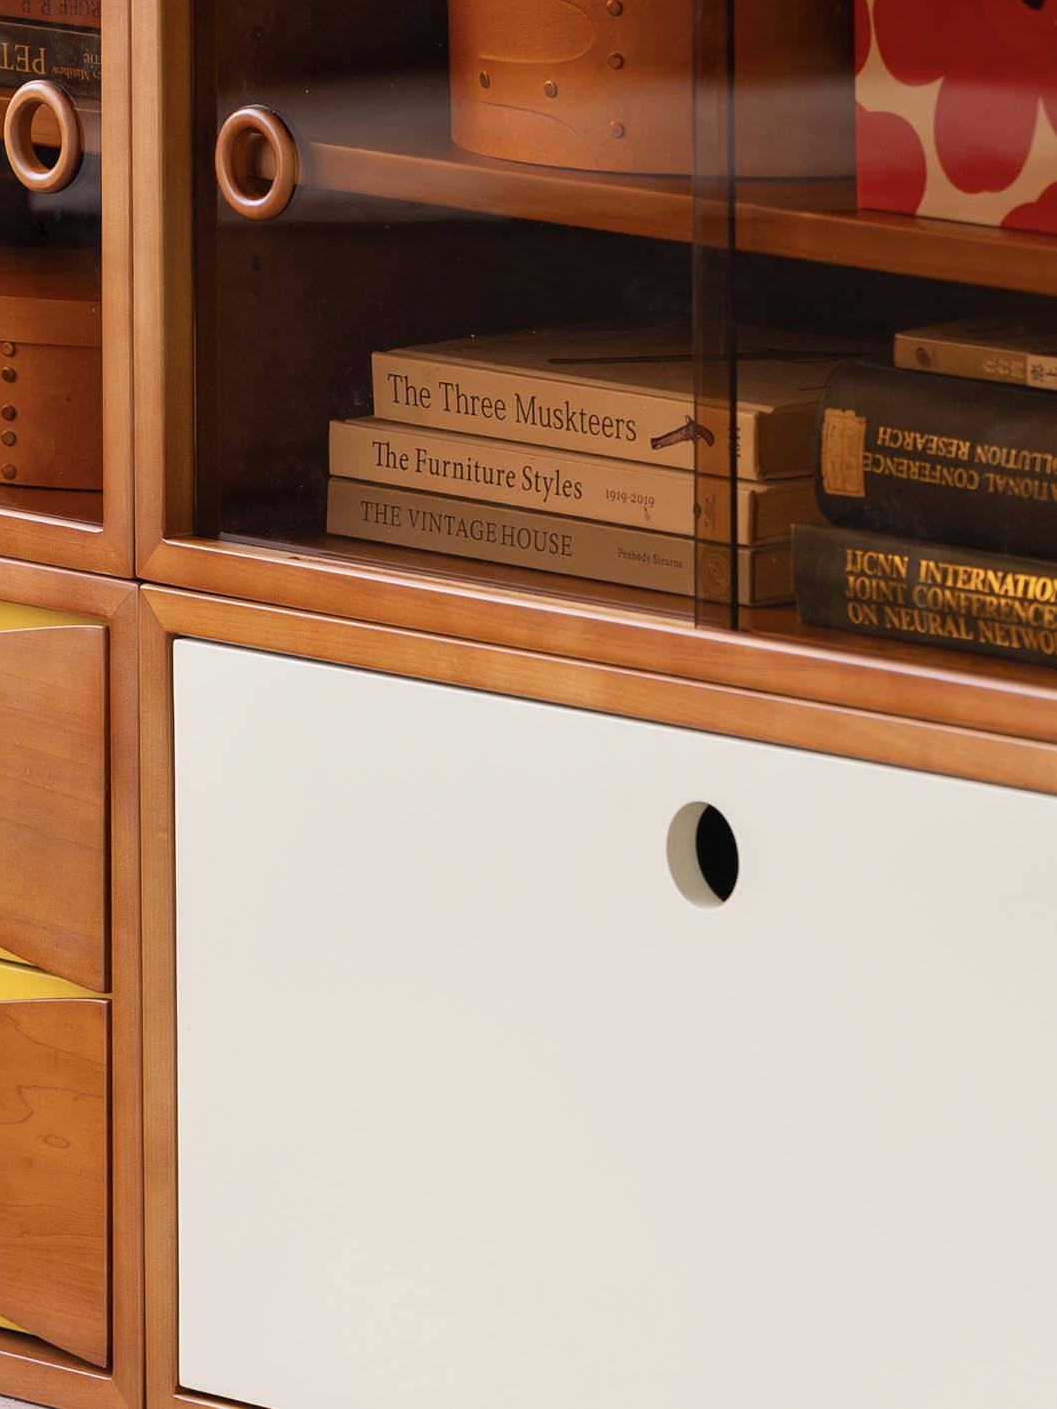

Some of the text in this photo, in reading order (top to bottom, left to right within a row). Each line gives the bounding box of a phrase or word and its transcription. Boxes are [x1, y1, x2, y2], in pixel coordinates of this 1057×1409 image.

[387, 372, 638, 442] The Three Musketeers
[876, 426, 971, 461] RESEARCH
[372, 440, 583, 502] The Furniture Styles
[863, 451, 980, 491] CONFERENCE
[605, 488, 655, 507] 1919-2019
[360, 500, 573, 558] THE VINTAGE HOUSE
[617, 547, 684, 570] Peabody Stearns
[845, 548, 910, 580] IJCNN
[845, 574, 907, 603] JOINT
[847, 601, 880, 626] ON
[884, 607, 974, 642] NEURAL
